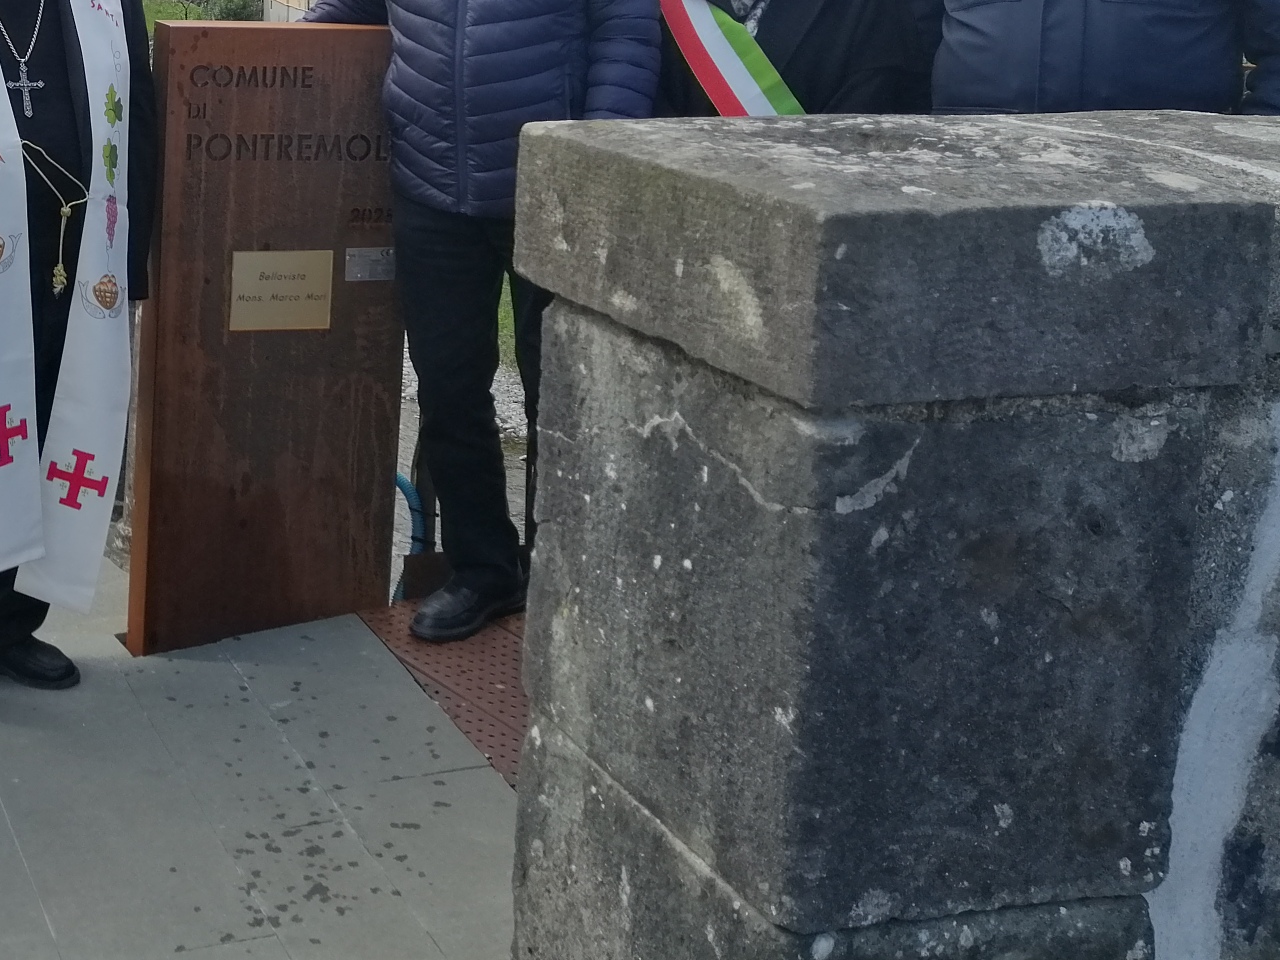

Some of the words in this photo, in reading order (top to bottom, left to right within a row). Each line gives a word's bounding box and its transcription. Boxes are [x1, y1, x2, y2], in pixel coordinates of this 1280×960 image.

[189, 64, 314, 89] COMUNE
[187, 102, 207, 120] DI
[185, 133, 388, 162] PONTREMOL
[258, 271, 307, 281] Bellavista
[235, 293, 265, 302] Mons.
[269, 292, 301, 302] Marco
